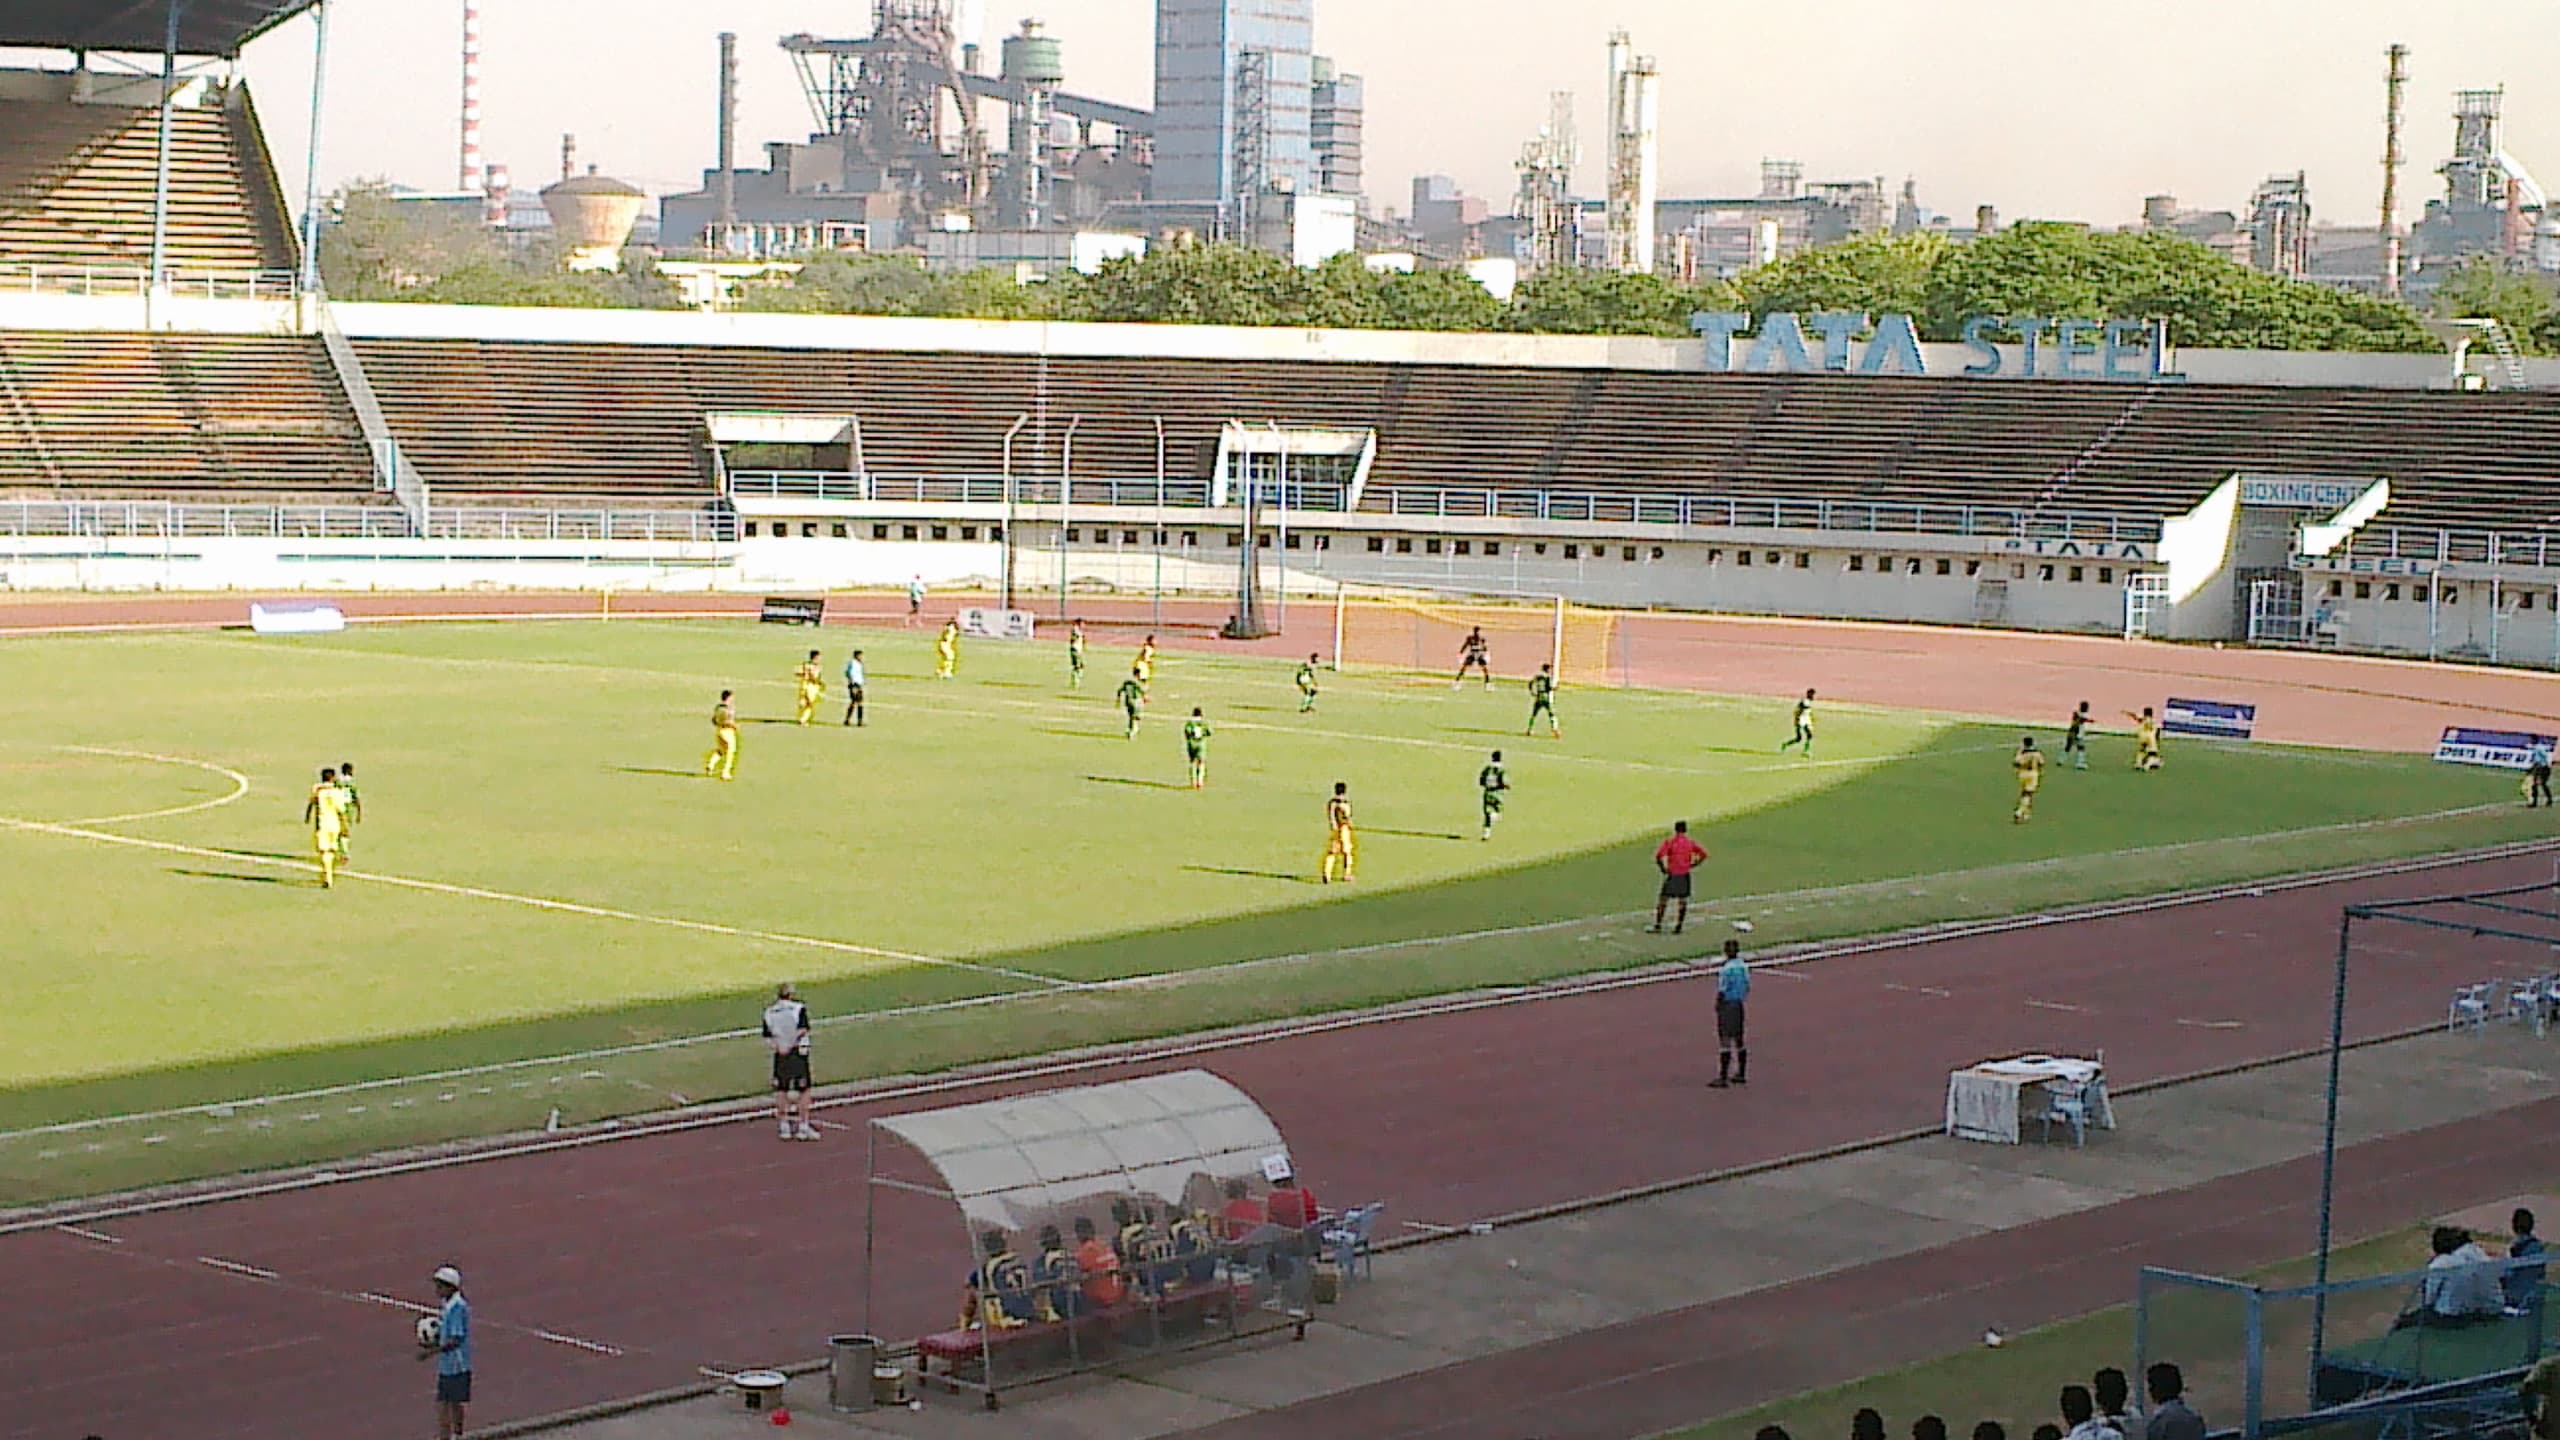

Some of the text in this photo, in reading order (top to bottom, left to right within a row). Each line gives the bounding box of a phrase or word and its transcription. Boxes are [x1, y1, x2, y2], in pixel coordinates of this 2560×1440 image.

[1691, 309, 2187, 384] TATA STEEL
[2243, 482, 2312, 501] BOXING
[2029, 540, 2143, 559] TATA
